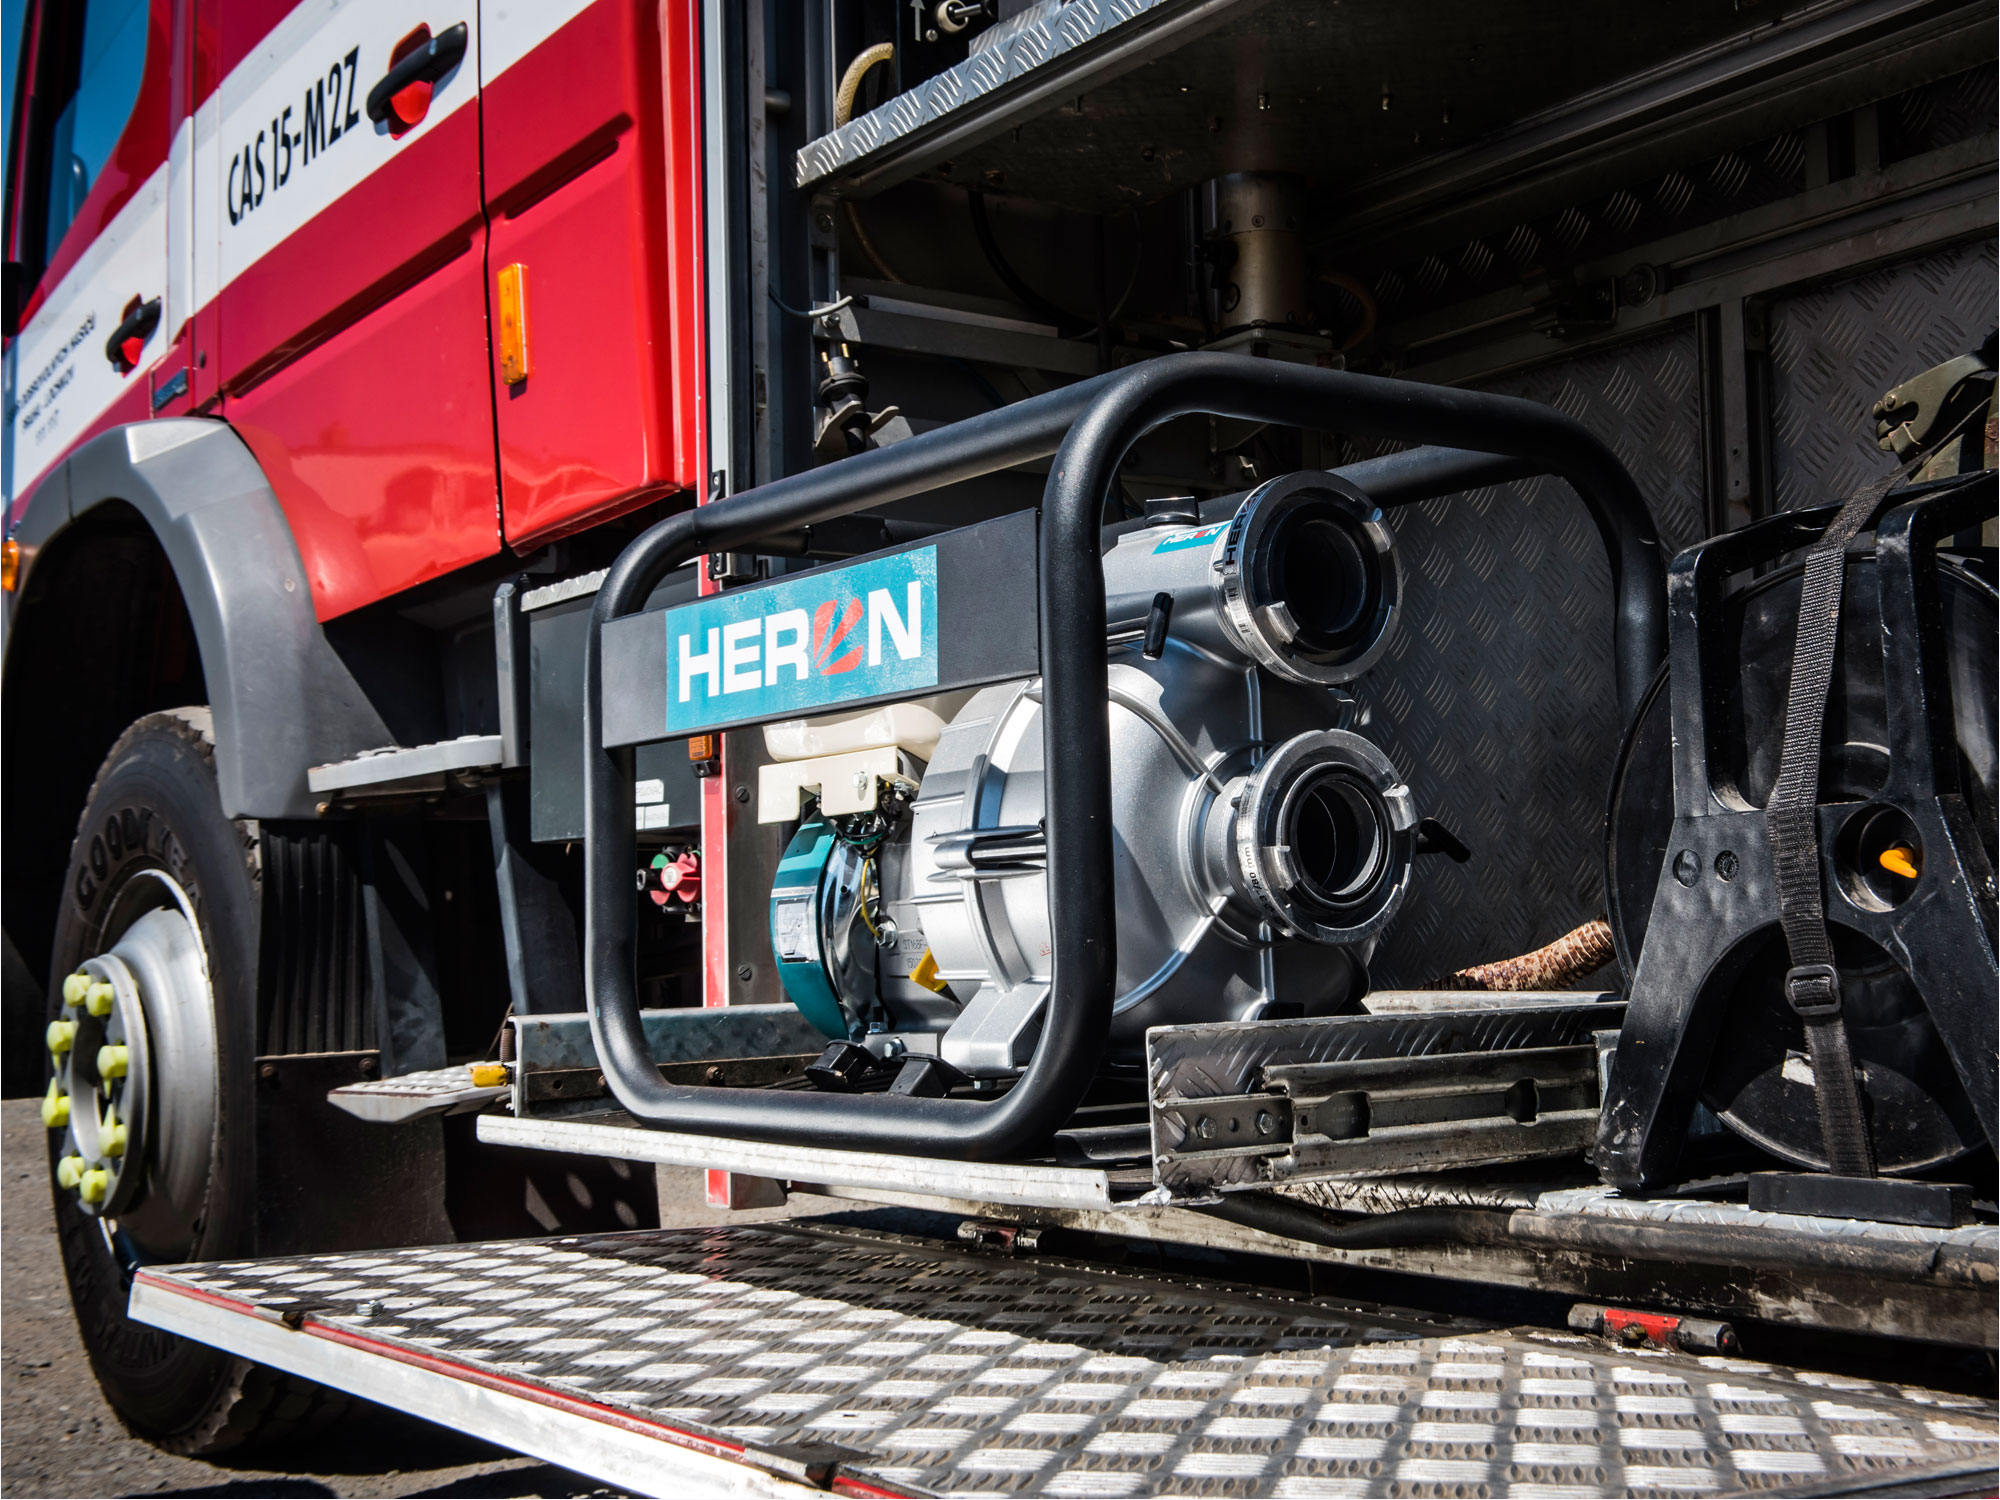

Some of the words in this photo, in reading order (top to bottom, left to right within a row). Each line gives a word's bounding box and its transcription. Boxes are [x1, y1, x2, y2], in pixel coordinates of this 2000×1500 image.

[227, 129, 266, 227] CAS
[272, 44, 360, 192] 15-M2Z
[678, 580, 922, 703] HERON
